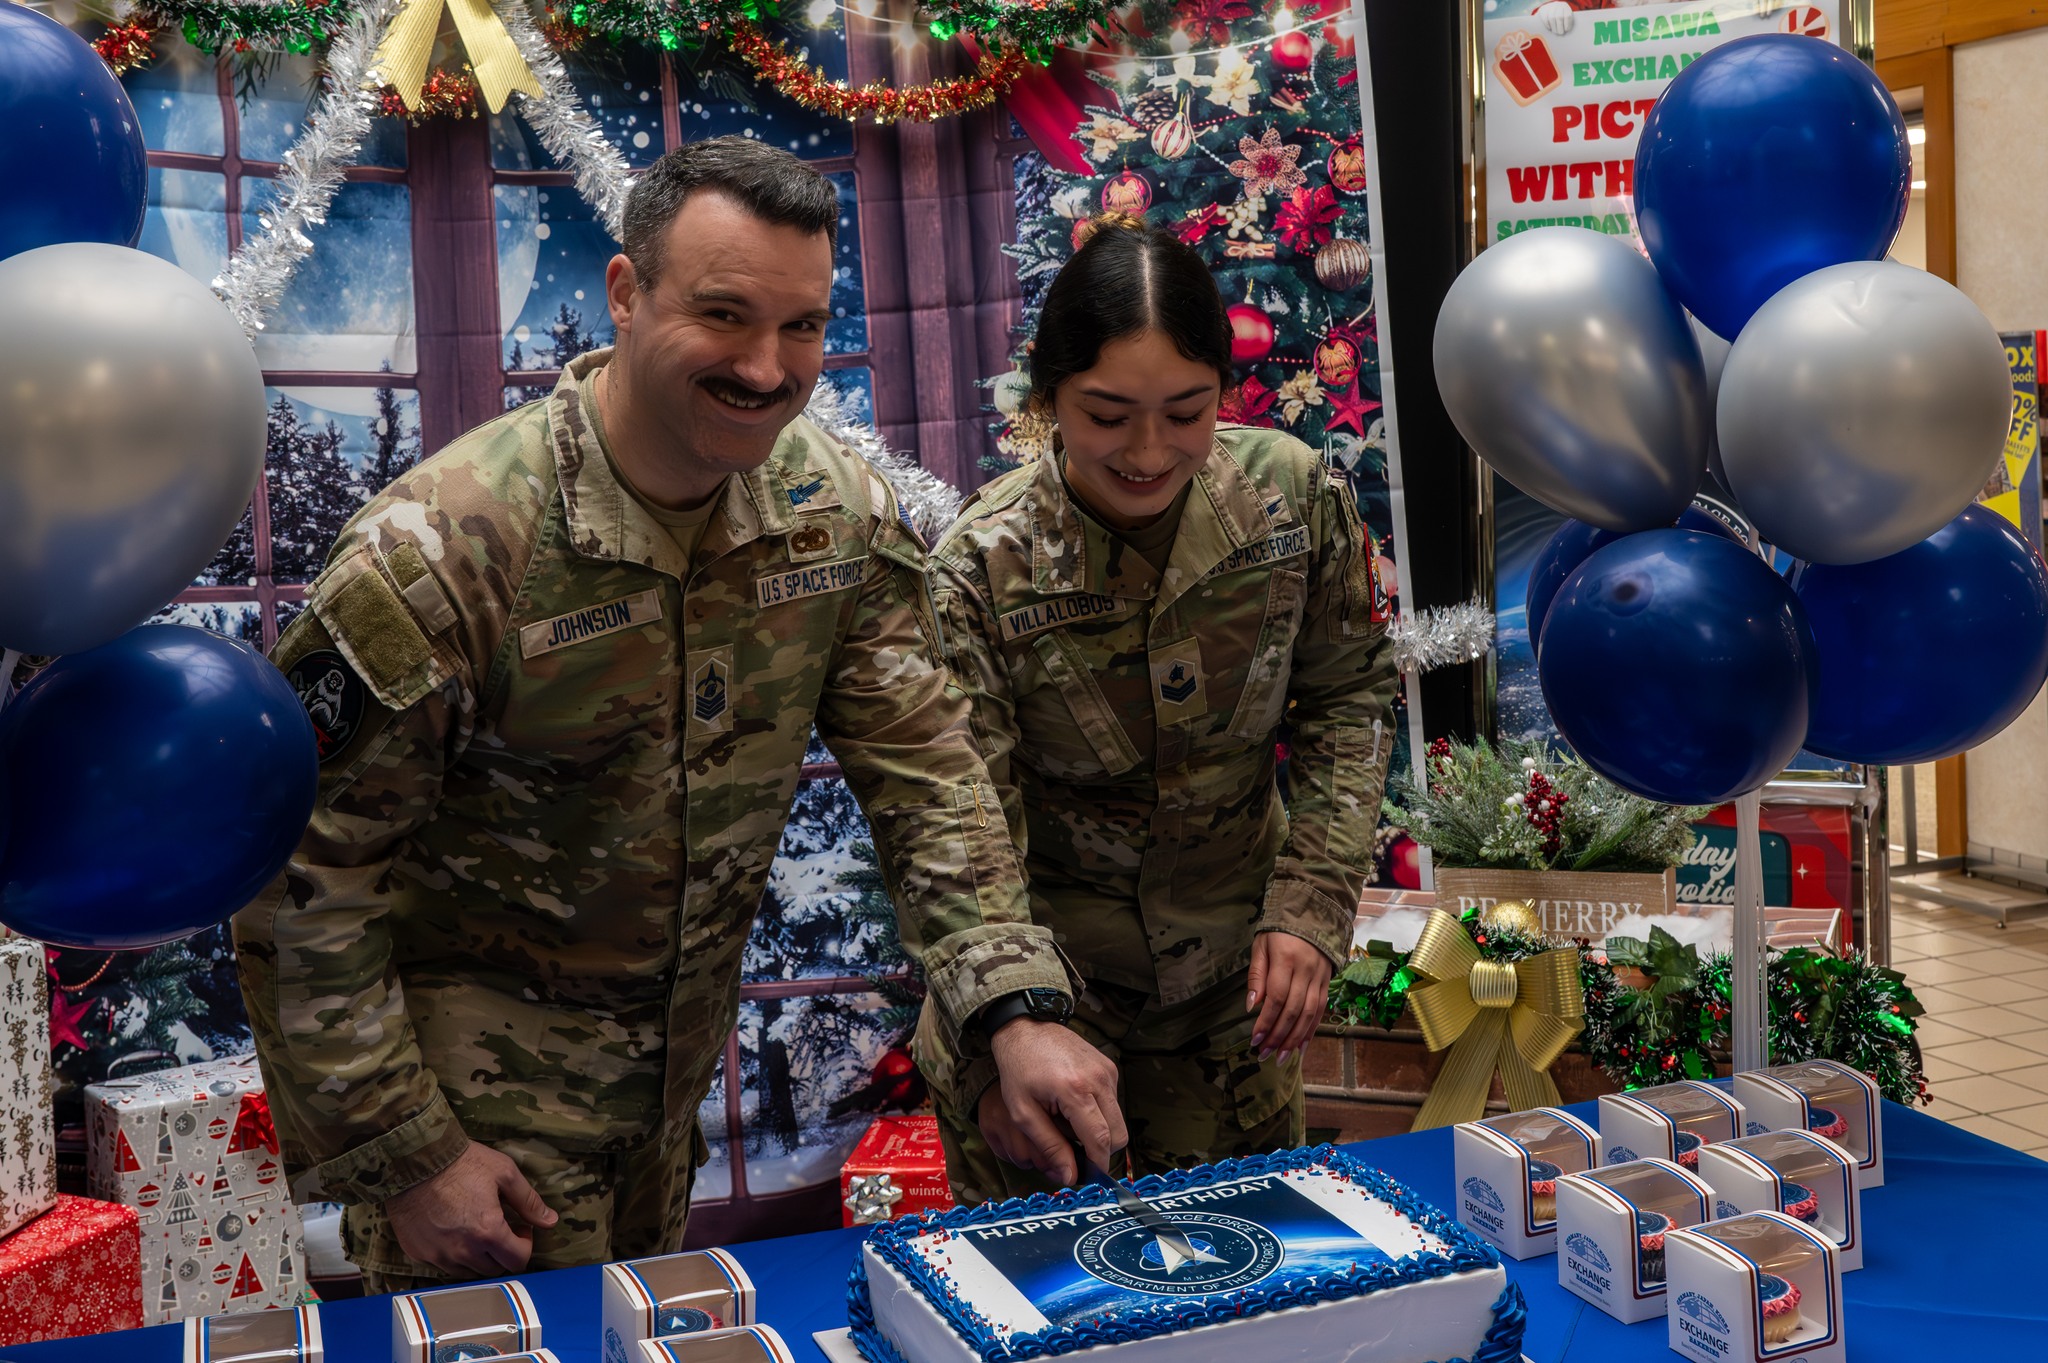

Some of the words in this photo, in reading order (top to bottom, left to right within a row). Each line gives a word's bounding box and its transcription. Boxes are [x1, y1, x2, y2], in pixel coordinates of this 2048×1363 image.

[1594, 10, 1721, 46] MISAWA
[1507, 159, 1634, 203] WITH
[1267, 531, 1306, 557] FORCE
[761, 575, 783, 604] U.S.
[786, 566, 830, 598] SPACE
[830, 560, 865, 588] FORCE
[547, 600, 632, 647] JOHNSON
[1009, 596, 1115, 636] VILLALOBOS
[976, 1216, 1079, 1240] HAPPY
[1085, 1206, 1124, 1224] 6TH
[1149, 1178, 1275, 1212] IRTHDAY
[1464, 1199, 1505, 1230] EXCHANGE
[1083, 1235, 1098, 1263] UNITED
[1099, 1219, 1141, 1237] STATE
[1162, 1214, 1204, 1222] PACE
[1208, 1216, 1258, 1234] FORCE
[1101, 1271, 1197, 1292] DEPARTMENT
[1202, 1282, 1222, 1292] OF
[1224, 1274, 1253, 1288] THE
[1252, 1264, 1265, 1277] AIR
[1261, 1241, 1275, 1266] FORCE
[1567, 1256, 1611, 1291] EXCHANGE
[1679, 1317, 1730, 1354] EXCHANGE
